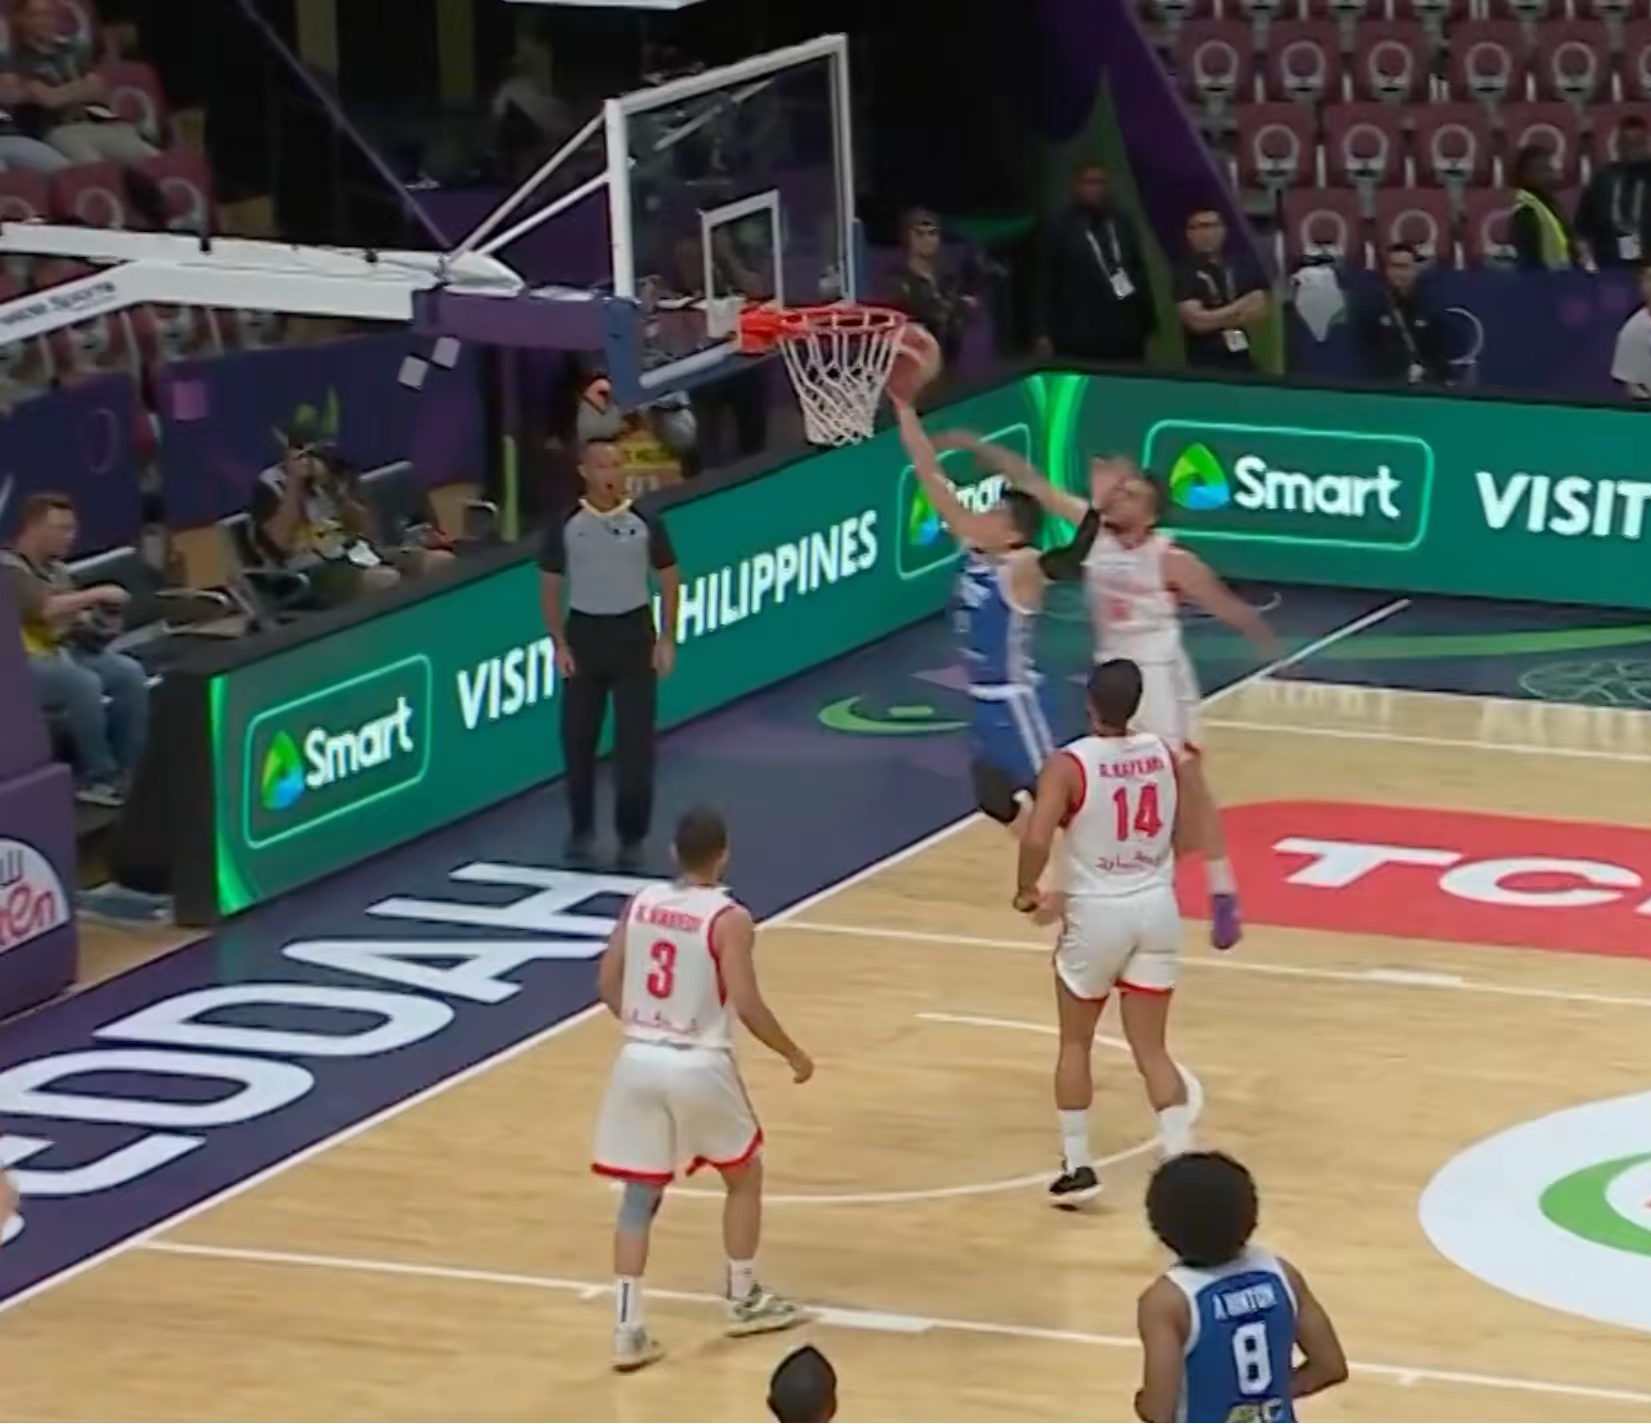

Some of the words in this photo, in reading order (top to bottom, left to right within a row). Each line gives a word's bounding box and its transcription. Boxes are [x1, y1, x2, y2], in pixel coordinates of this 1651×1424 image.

[1233, 455, 1401, 518] Smart
[456, 635, 556, 731] VISIT
[303, 696, 414, 790] Smart
[1113, 783, 1163, 842] 14
[646, 939, 677, 1000] 3
[1232, 1322, 1272, 1395] 8
